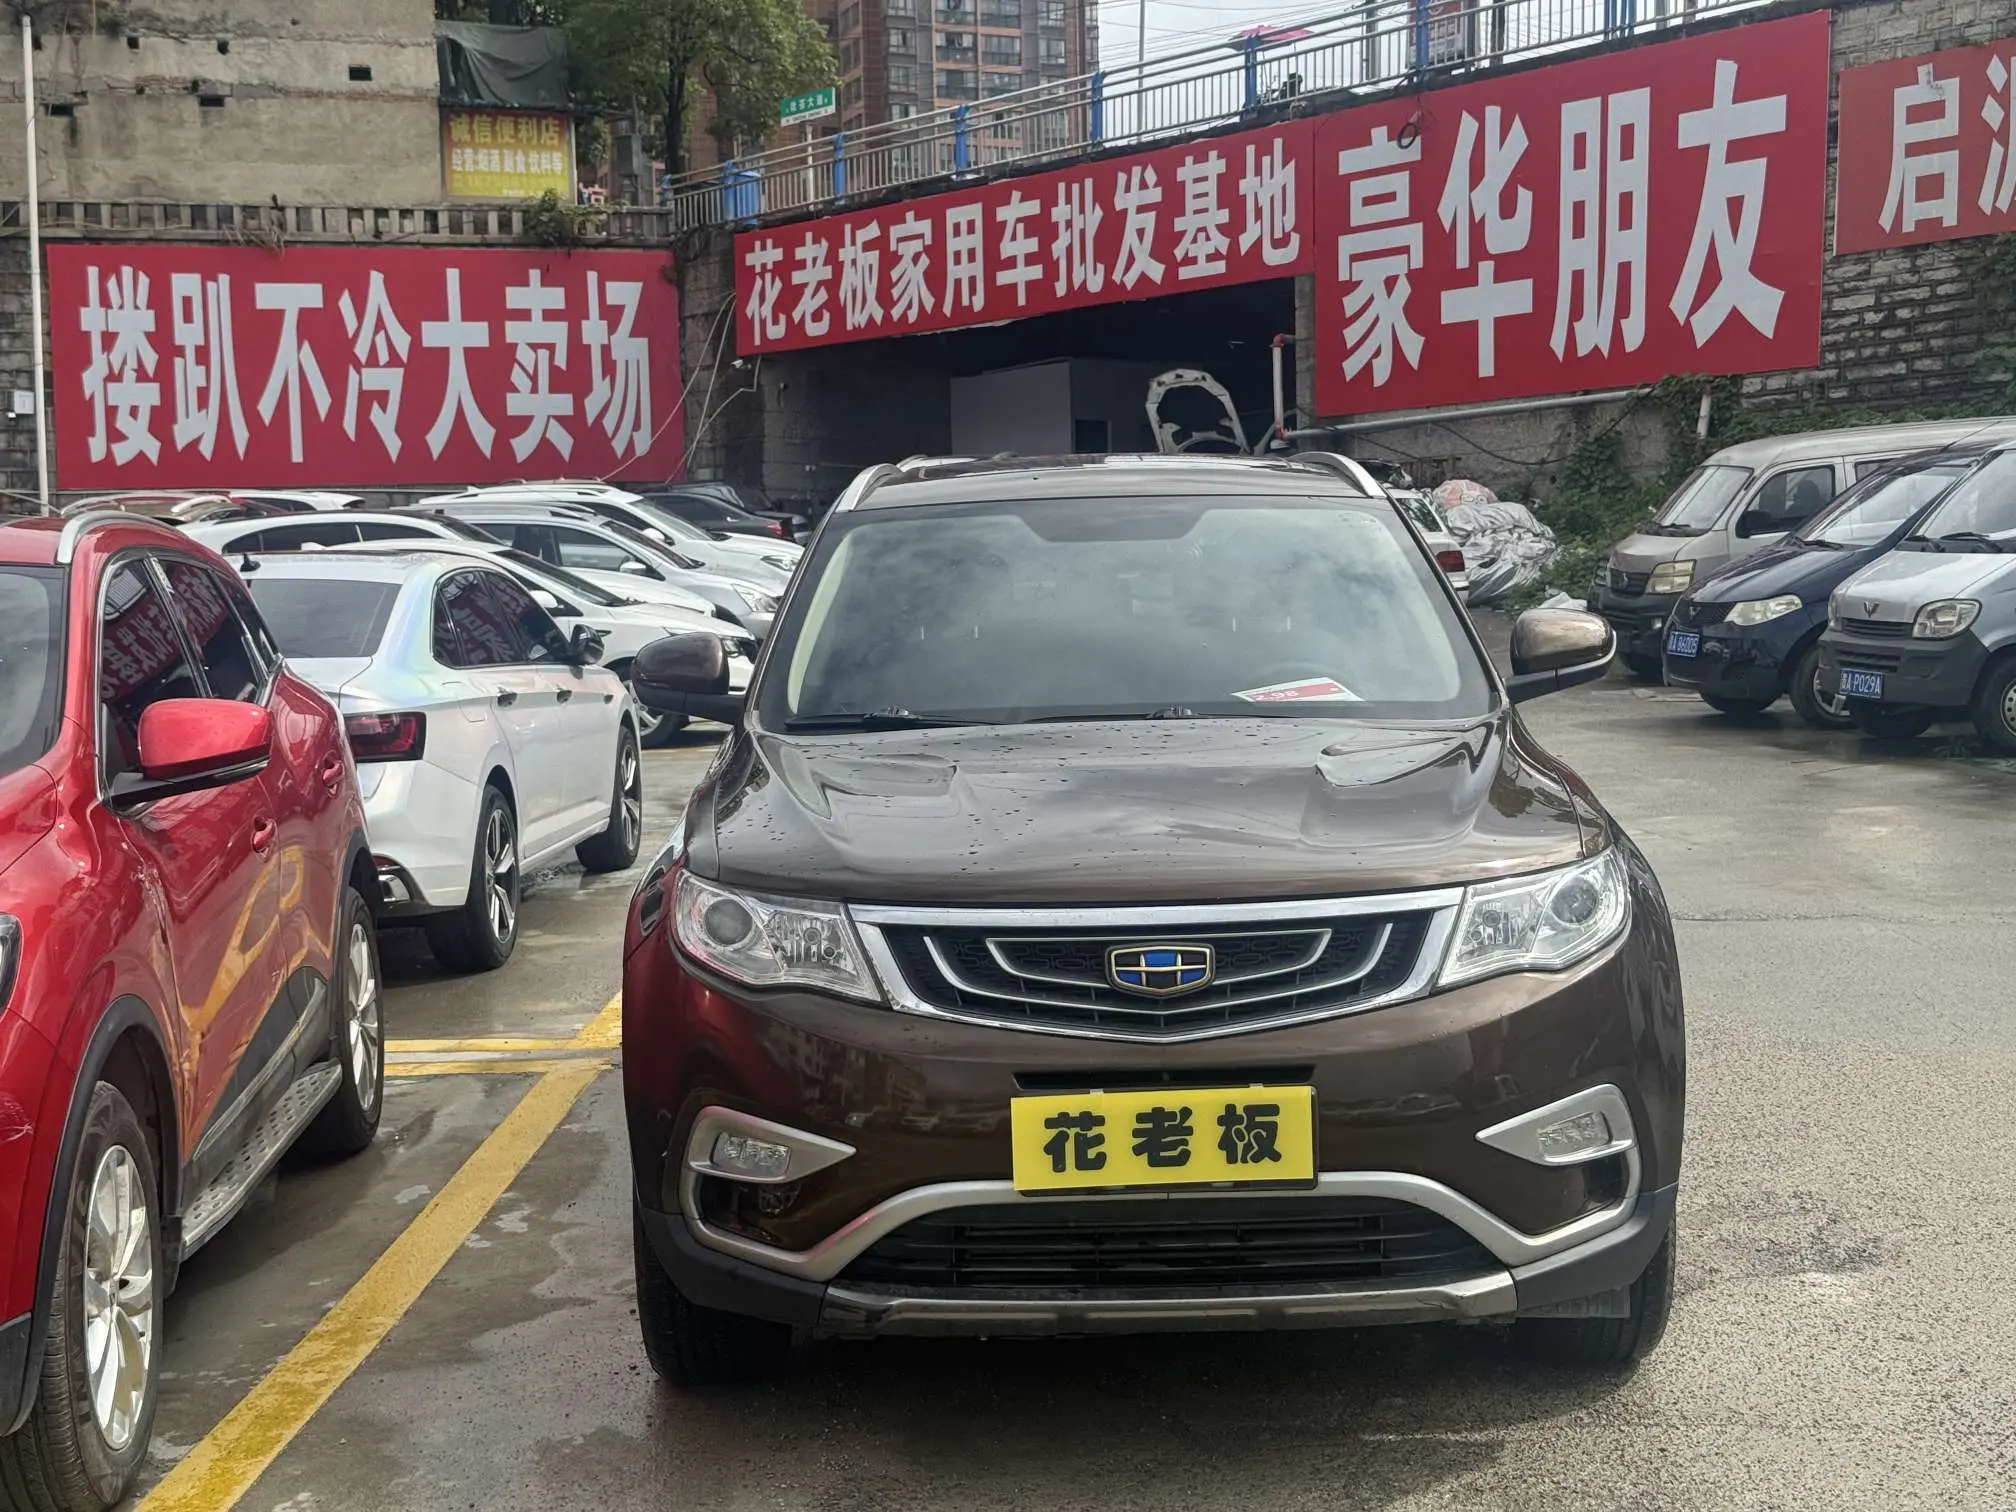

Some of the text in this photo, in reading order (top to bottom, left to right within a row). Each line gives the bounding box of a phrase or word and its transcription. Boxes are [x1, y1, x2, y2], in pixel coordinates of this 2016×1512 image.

[449, 113, 561, 147] 诚信便利店
[1337, 58, 1788, 388] 豪华朋友
[745, 137, 1300, 346] 花老板家用车批发基地
[80, 265, 652, 467] 搂趴不冷大卖场
[1043, 1103, 1282, 1173] 花老板
